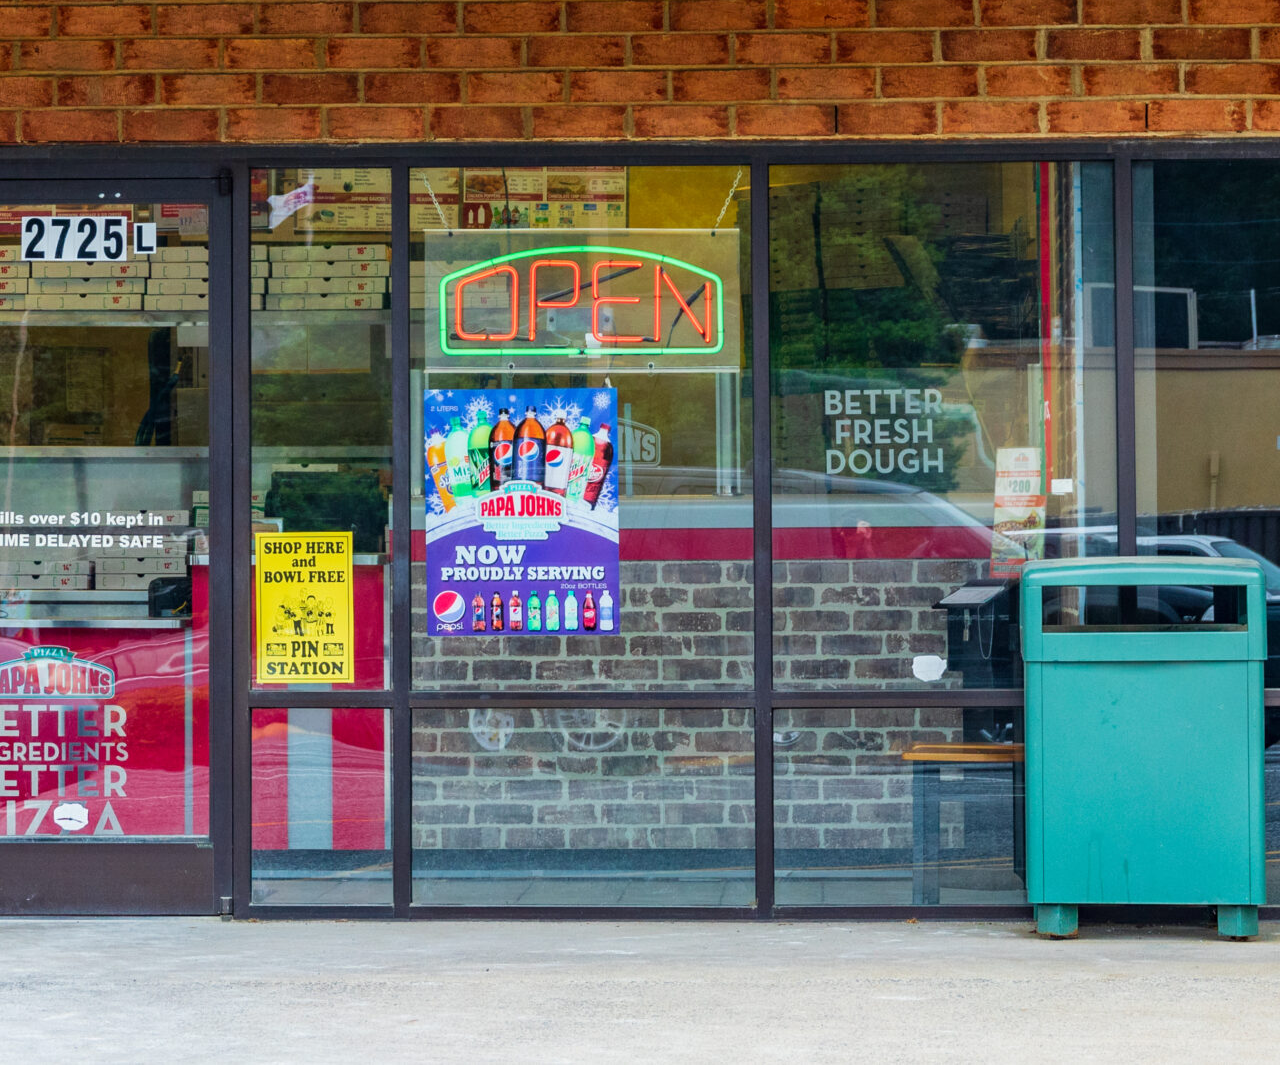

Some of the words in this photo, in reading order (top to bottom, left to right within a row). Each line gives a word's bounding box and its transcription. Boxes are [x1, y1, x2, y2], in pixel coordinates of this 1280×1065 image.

[24, 217, 123, 259] 2725
[136, 225, 154, 252] L
[455, 259, 712, 343] OPEN
[824, 388, 943, 416] BETTER
[835, 419, 933, 444] FRESH
[826, 448, 944, 474] DOUGH
[481, 495, 515, 516] PAPA
[29, 514, 66, 525] over
[70, 511, 101, 526] $10
[107, 512, 143, 528] kept
[148, 512, 164, 525] in
[35, 534, 114, 548] DELAYED
[119, 535, 164, 548] SAFE
[264, 542, 302, 554] SHOP
[306, 541, 344, 554] HERE
[292, 556, 316, 567] and
[455, 545, 526, 565] NOW
[264, 571, 305, 583] BOWL
[309, 571, 345, 583] FREE
[440, 566, 525, 581] PROUDLY
[527, 566, 605, 581] SERVING
[33, 648, 65, 657] PIZZA
[291, 641, 319, 658] PIN
[266, 661, 344, 675] STATION
